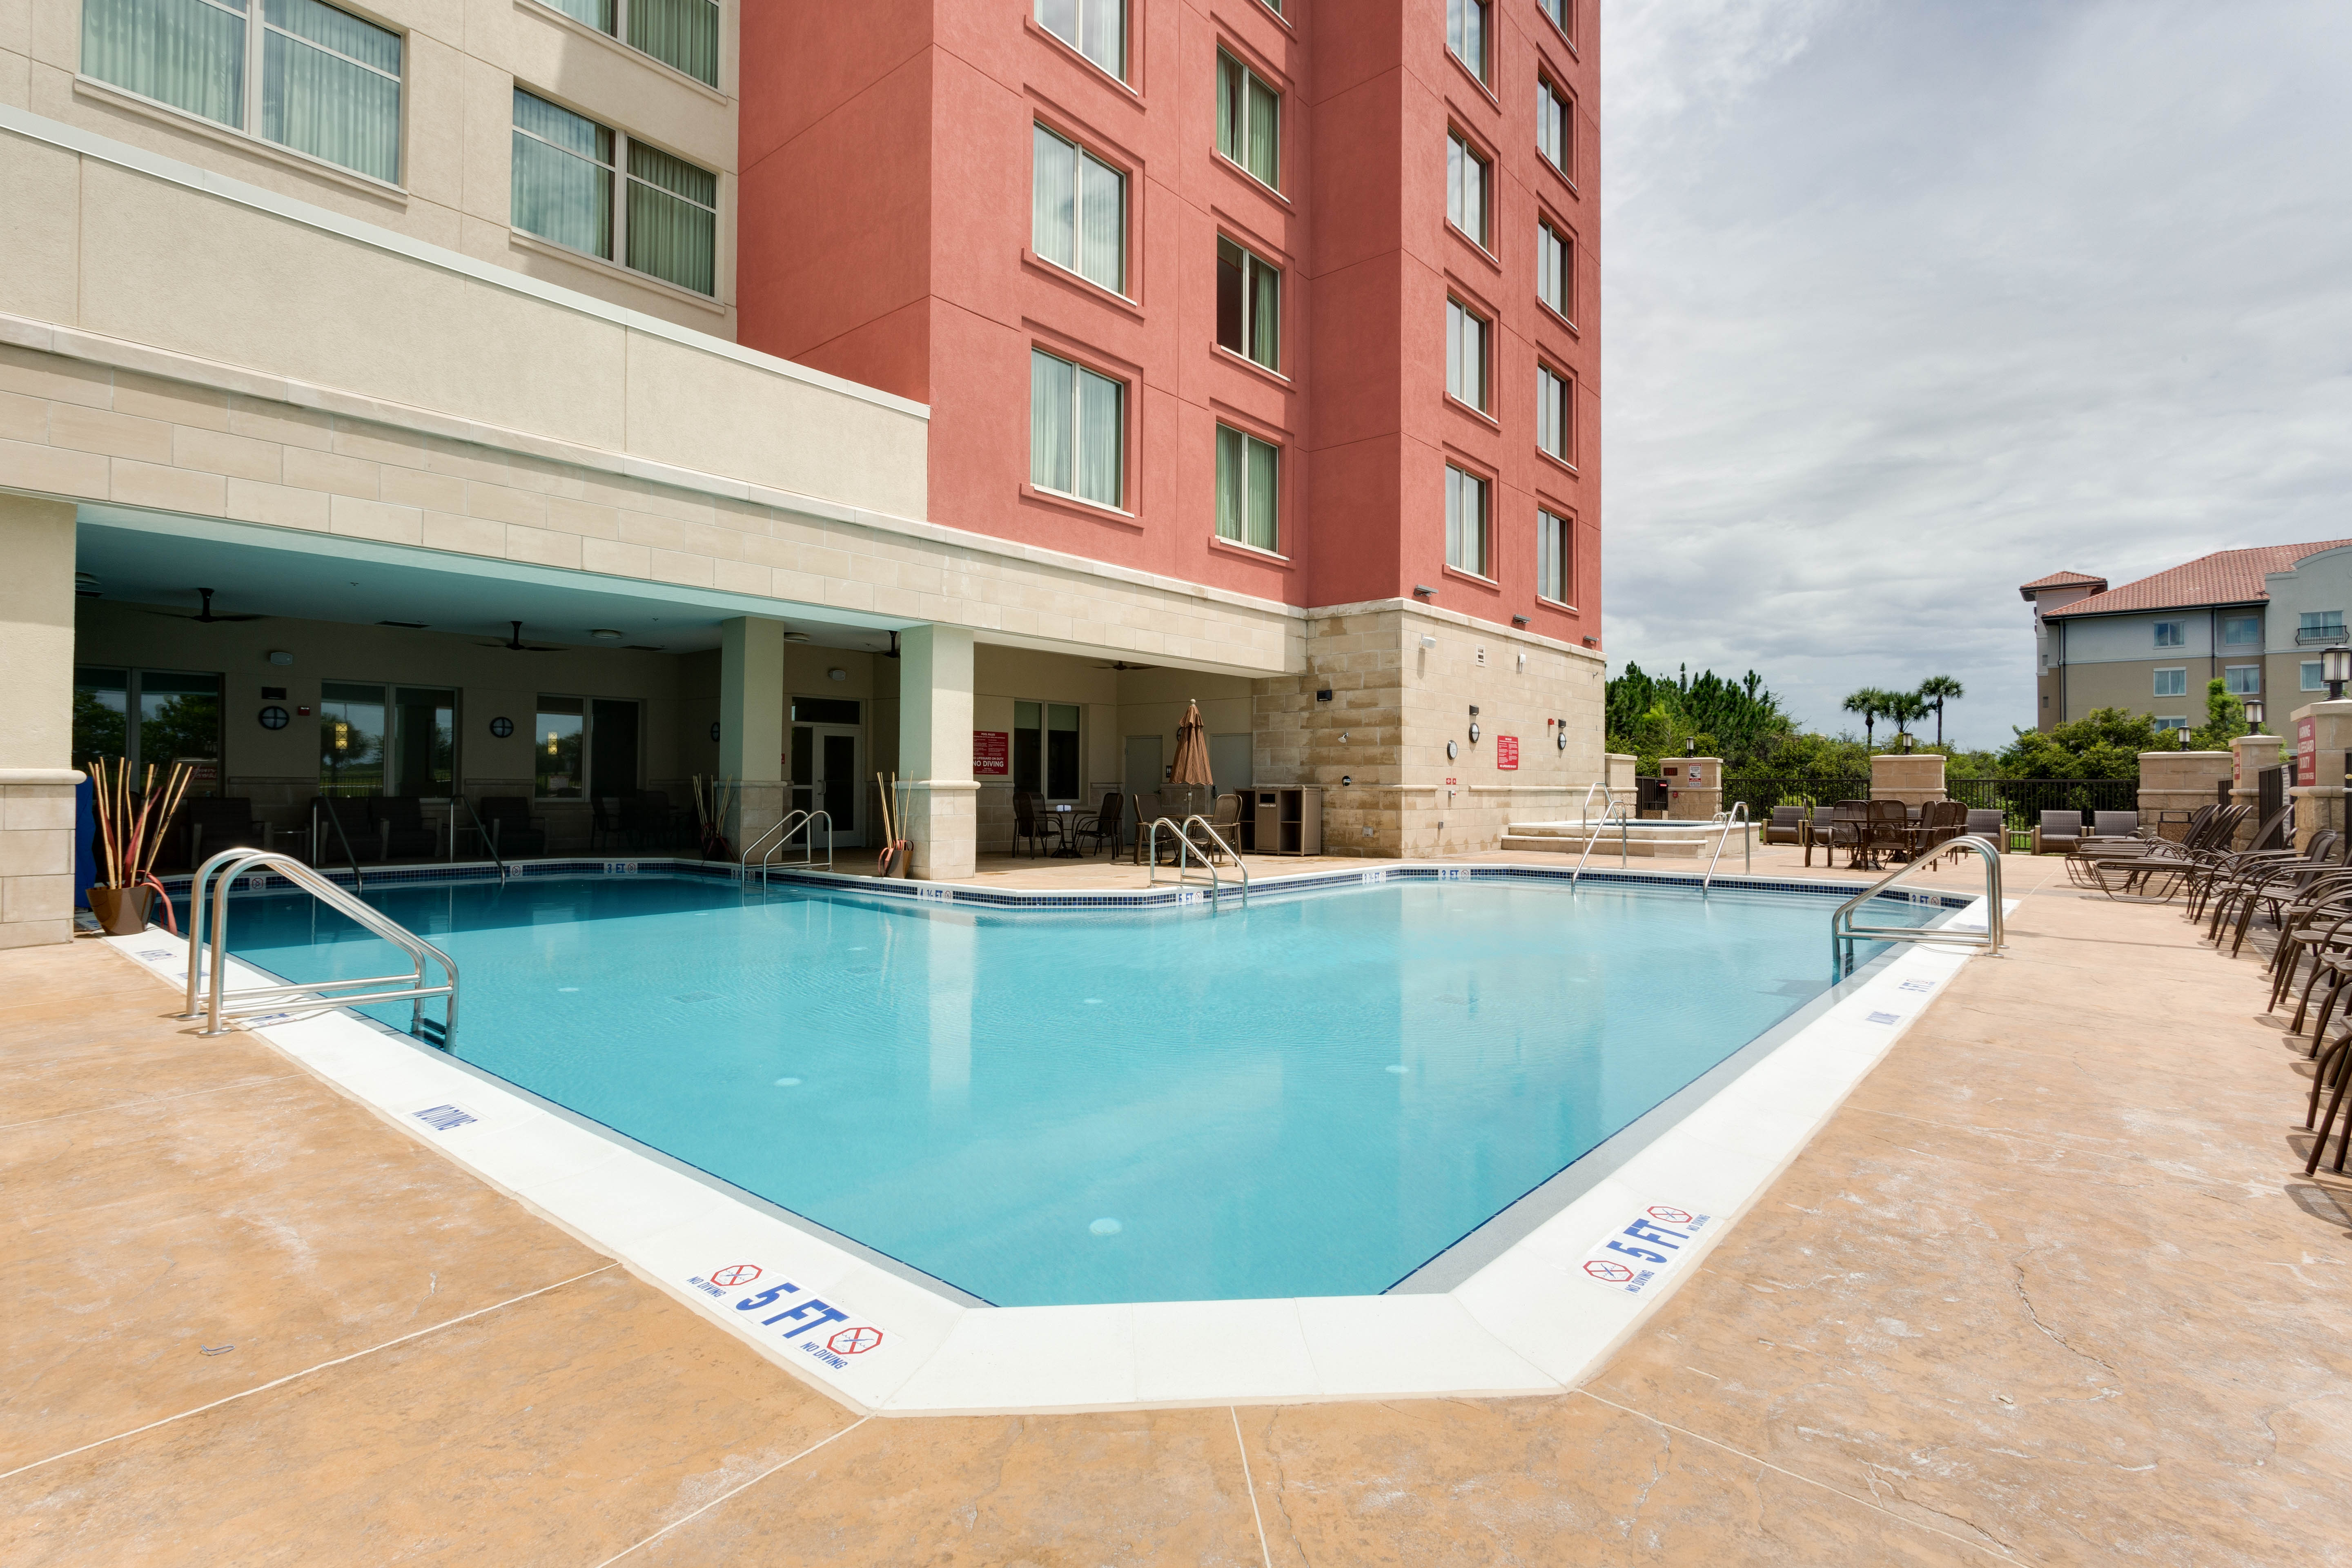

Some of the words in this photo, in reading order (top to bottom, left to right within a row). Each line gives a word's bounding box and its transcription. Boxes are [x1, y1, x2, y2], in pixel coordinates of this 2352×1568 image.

[1920, 895, 1929, 904] FT
[1691, 1214, 1711, 1226] DIVING
[1623, 1218, 1690, 1250] FT
[1606, 1240, 1667, 1263] 5
[686, 1276, 704, 1284] NO
[697, 1282, 726, 1297] DIVING
[1624, 1284, 1641, 1293] NO
[1631, 1270, 1655, 1286] DIVING
[736, 1282, 800, 1311] 5
[761, 1298, 850, 1339] FT
[800, 1341, 820, 1352] NO
[813, 1349, 848, 1369] DIVING
